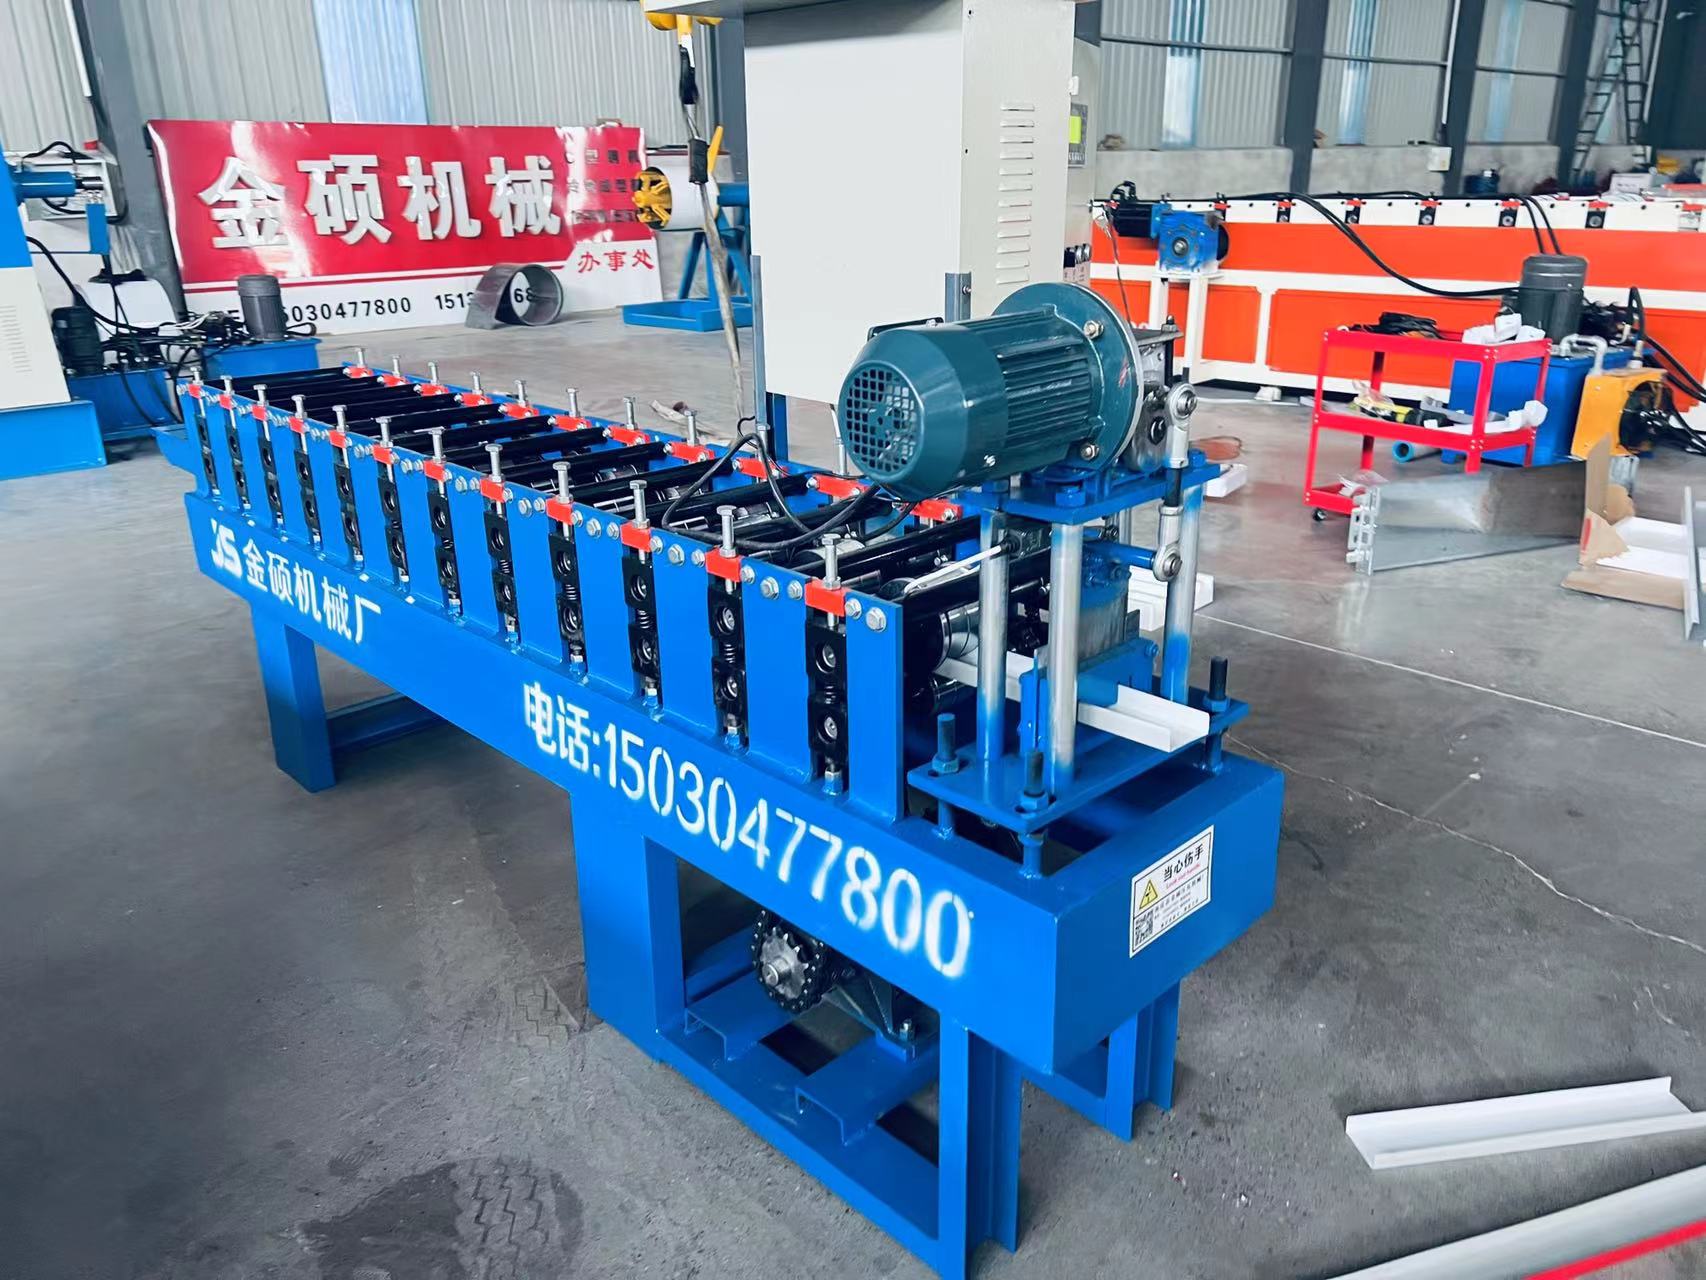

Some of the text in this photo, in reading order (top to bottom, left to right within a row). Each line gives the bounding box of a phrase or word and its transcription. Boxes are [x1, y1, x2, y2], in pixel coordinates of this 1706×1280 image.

[198, 153, 562, 250] 金硕机械
[577, 249, 655, 273] 办事处
[242, 538, 382, 644] 金硕机械厂
